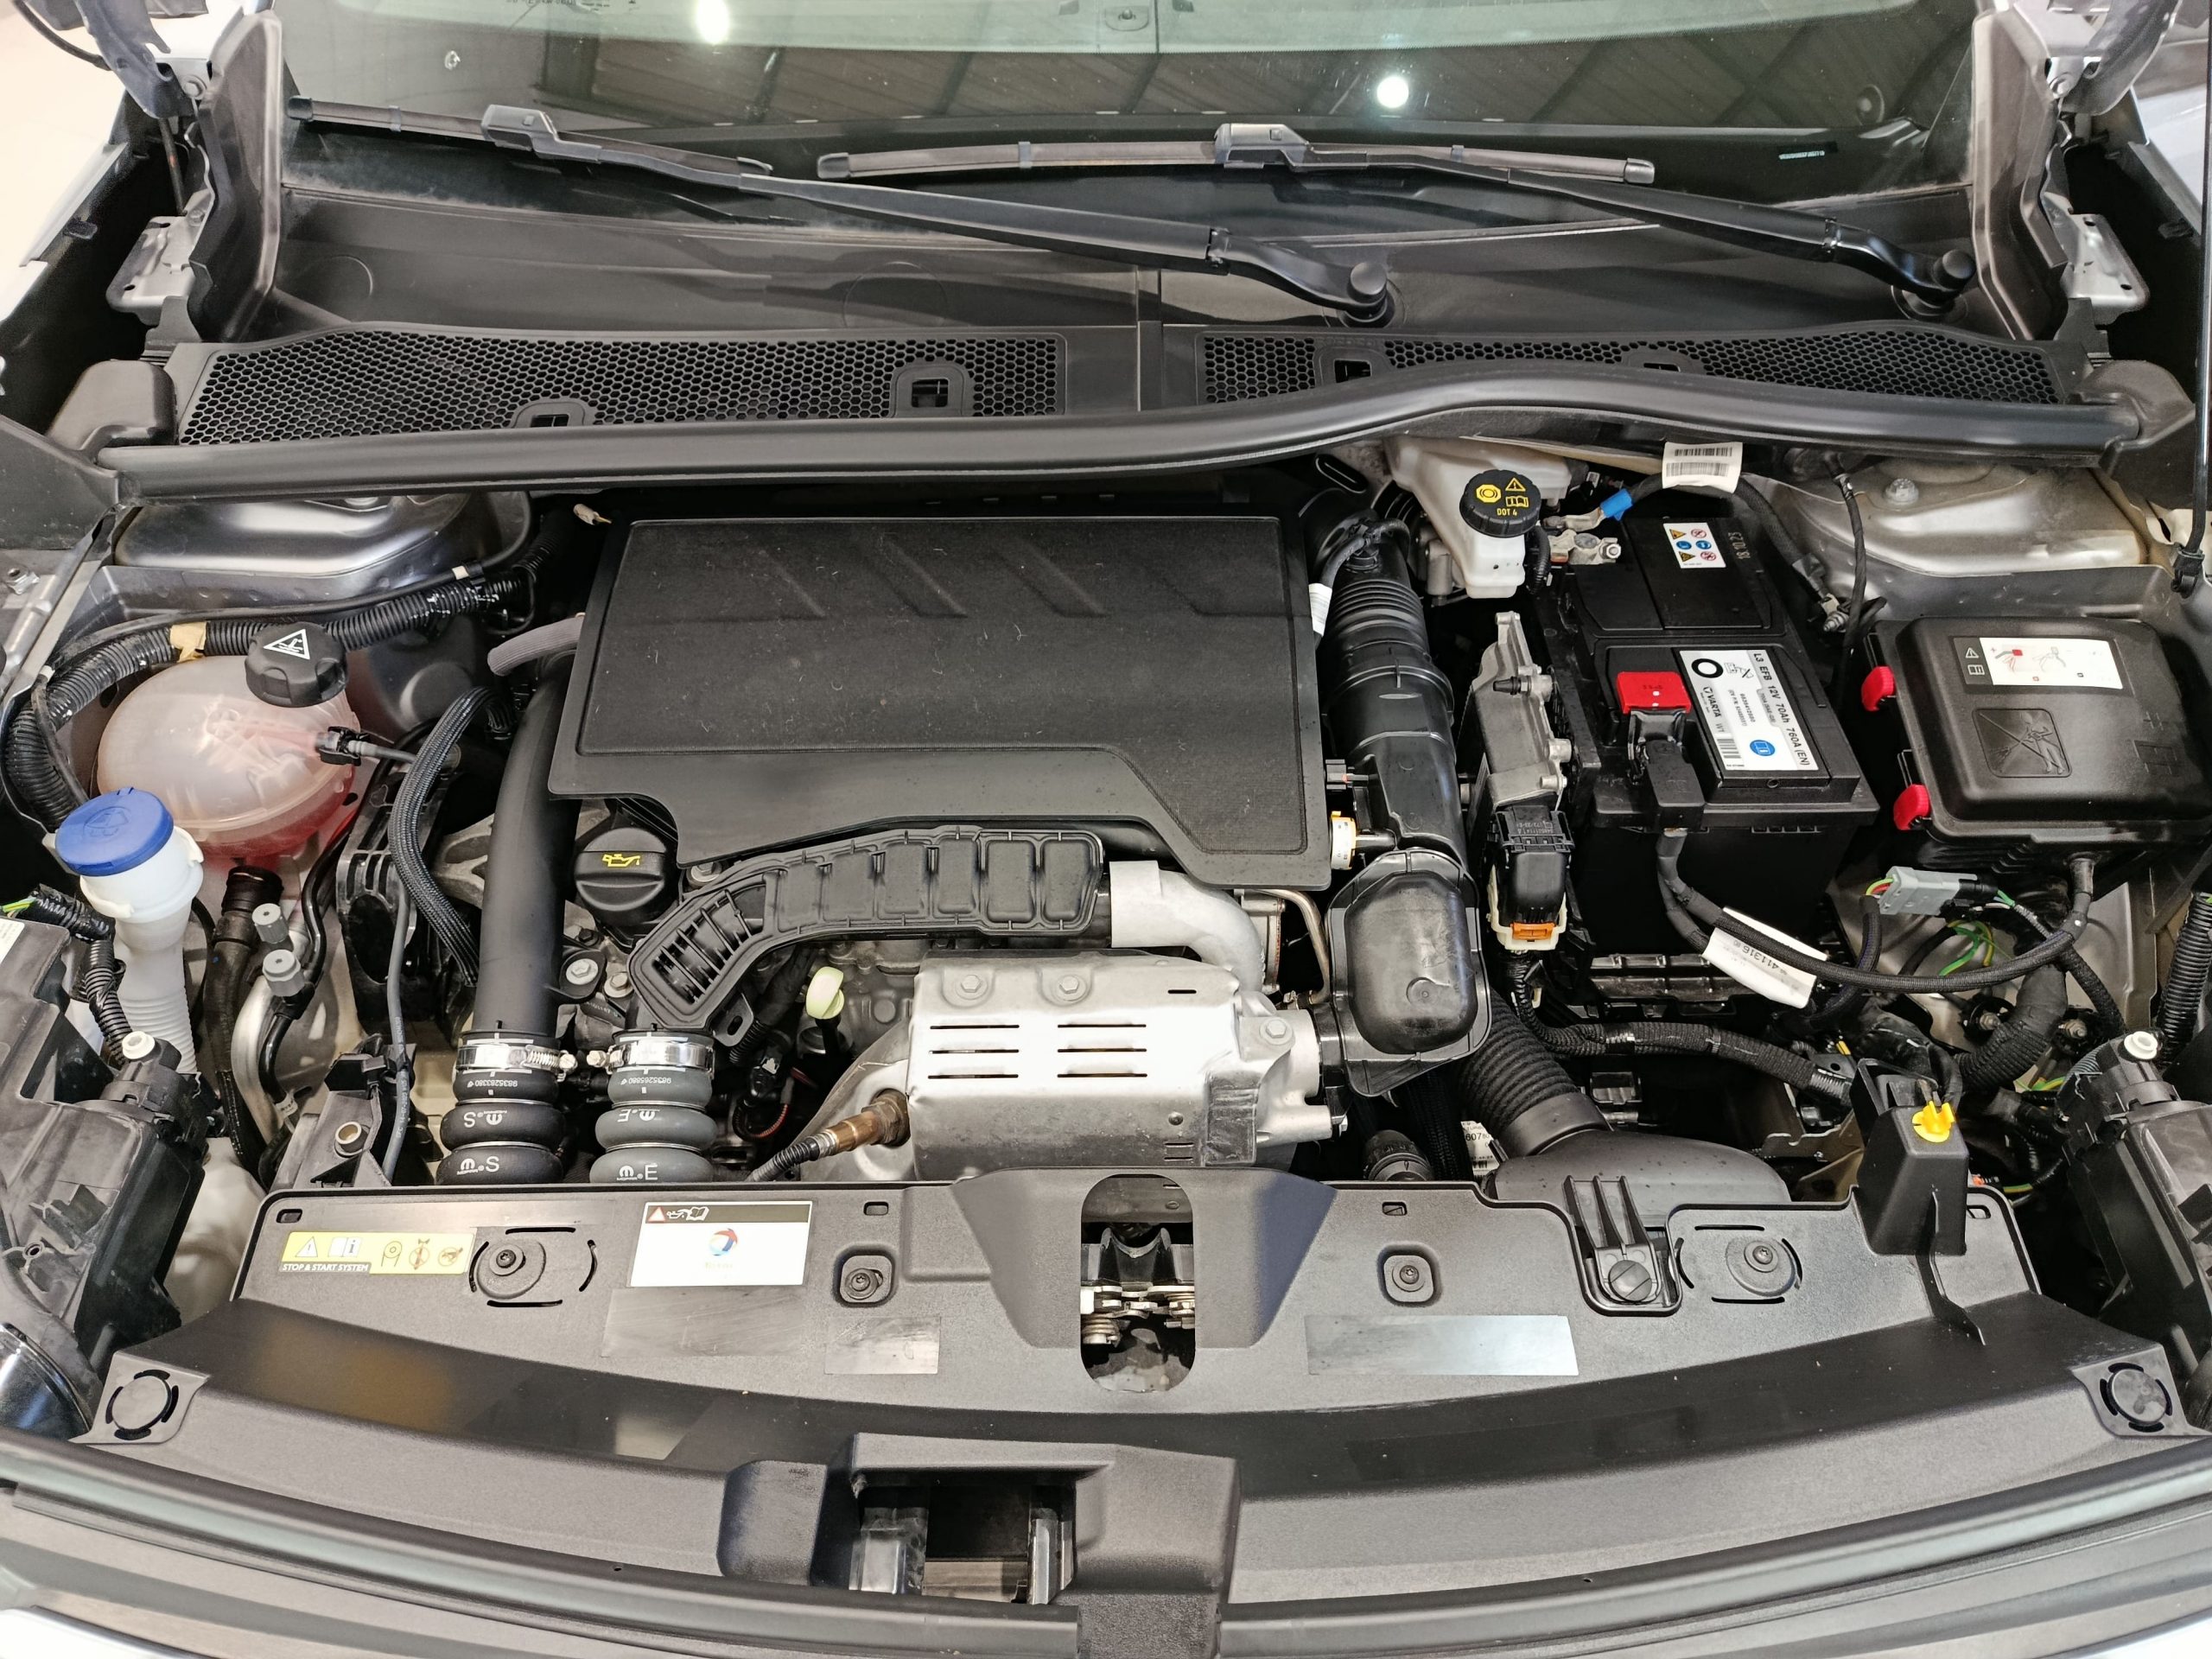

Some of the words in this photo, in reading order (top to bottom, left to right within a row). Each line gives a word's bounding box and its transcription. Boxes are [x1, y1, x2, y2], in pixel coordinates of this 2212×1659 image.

[1707, 690, 1722, 718] VARTA
[1753, 652, 1764, 663] L3
[1759, 665, 1772, 681] EFB
[1768, 685, 1781, 699] 12V
[1776, 702, 1789, 723] 70Ah
[1786, 727, 1802, 748] 760A
[1795, 748, 1810, 766] (EN)
[463, 1111, 476, 1128] S
[617, 1109, 632, 1122] E
[486, 1155, 499, 1173] S
[645, 1163, 658, 1180] E
[338, 1263, 369, 1272] SYSTEM
